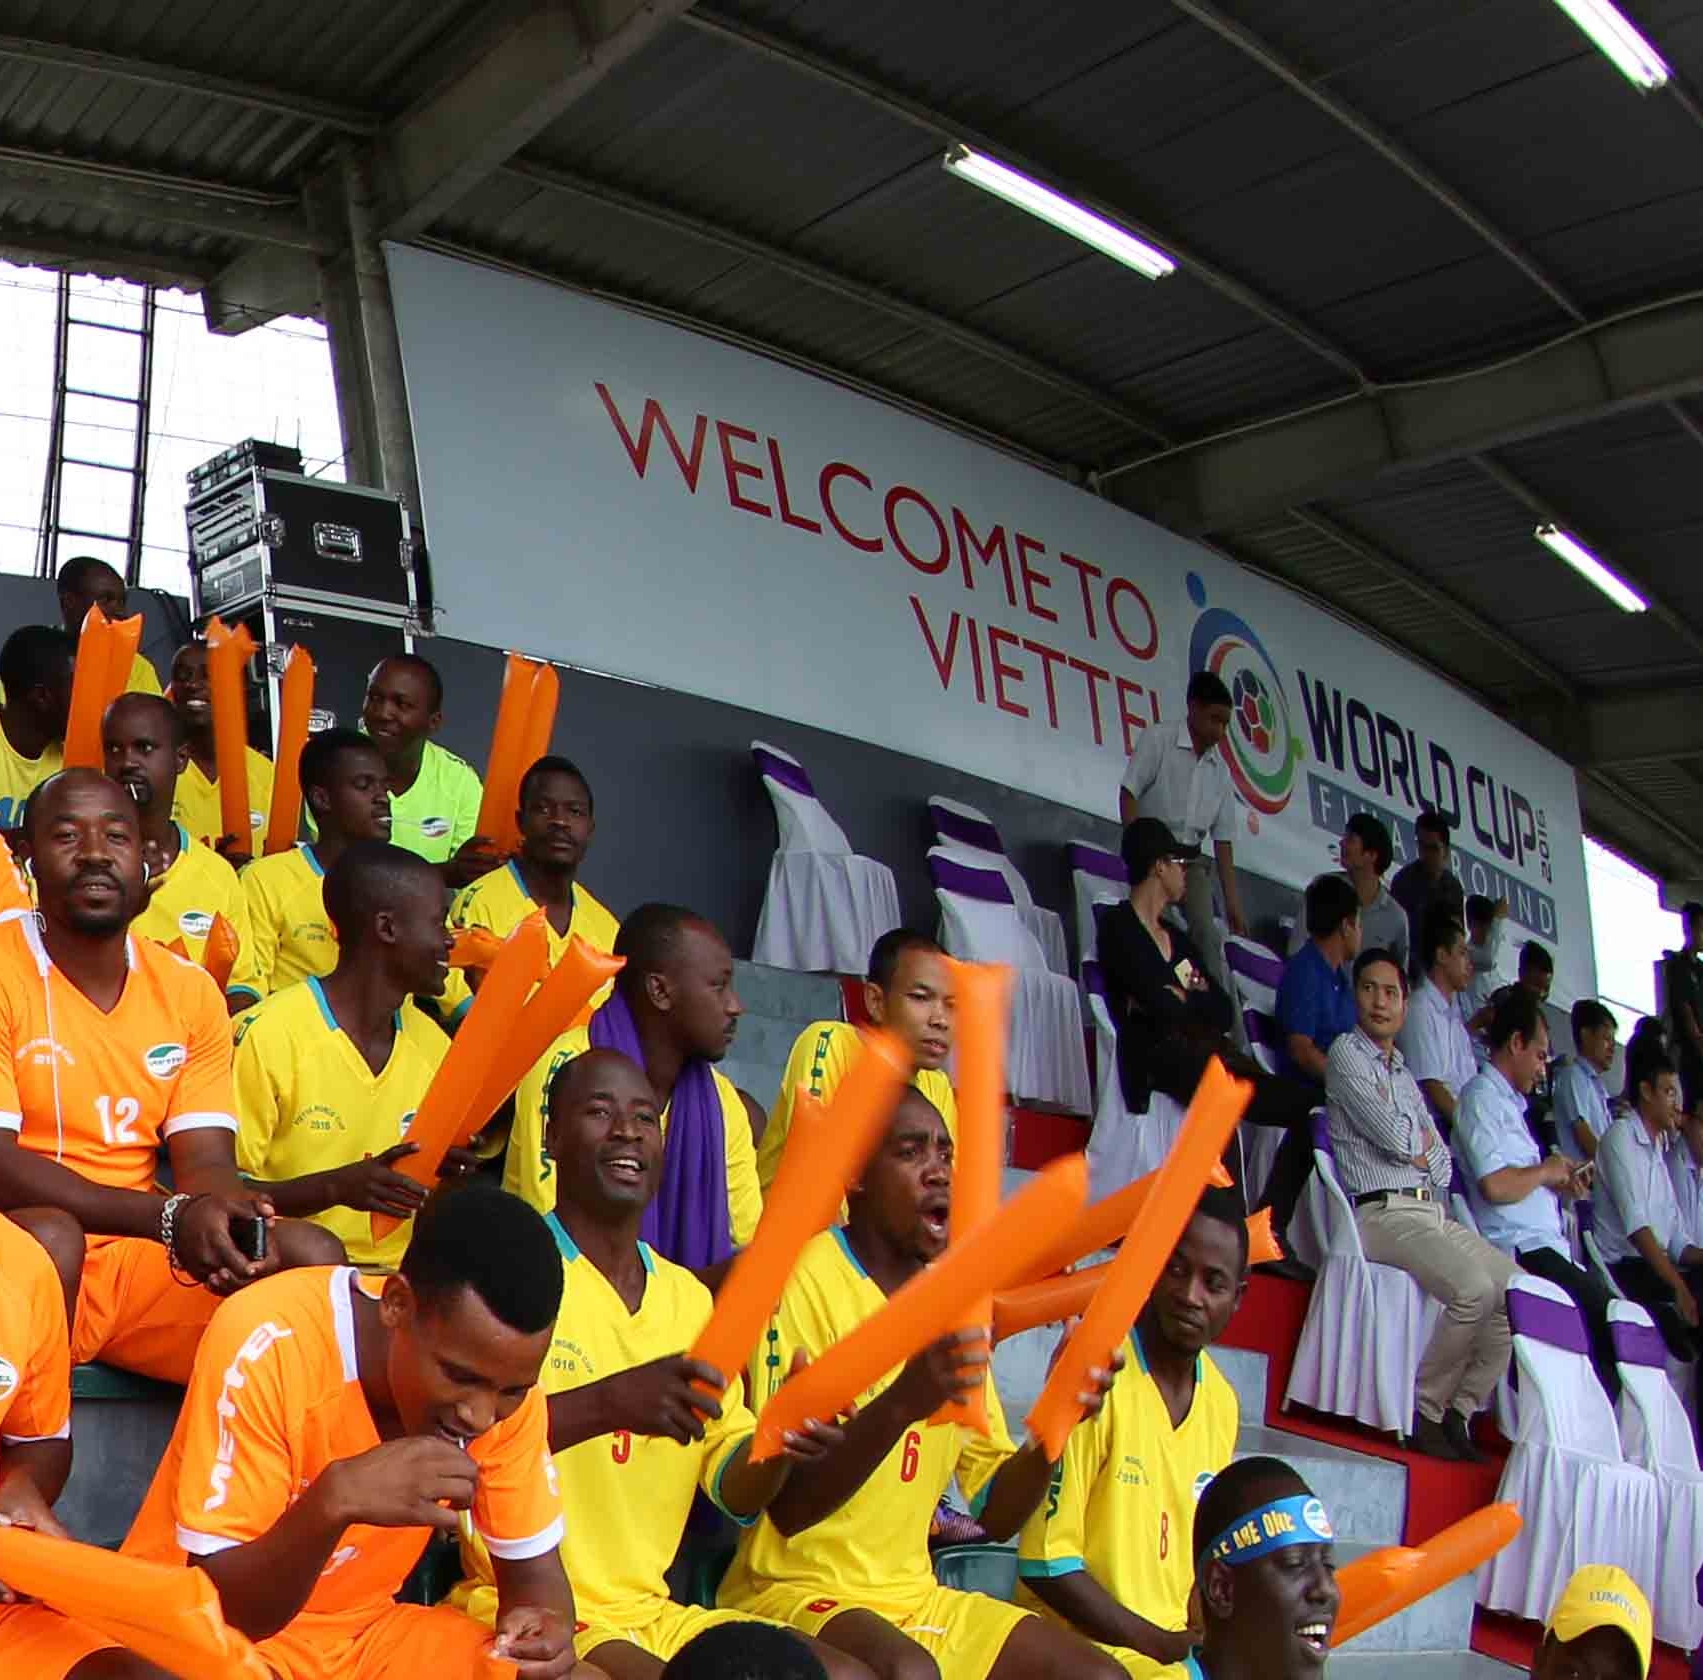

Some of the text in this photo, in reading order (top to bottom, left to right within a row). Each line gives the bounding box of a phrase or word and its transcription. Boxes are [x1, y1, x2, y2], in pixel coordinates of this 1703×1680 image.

[594, 375, 1159, 661] WELCOME TO
[1296, 668, 1537, 867] WORLD CUP
[1538, 808, 1554, 884] 2016
[94, 1095, 139, 1144] 12
[202, 1321, 294, 1514] VIETTEL
[900, 1430, 922, 1483] 6
[1159, 1510, 1170, 1561] 8
[1232, 1509, 1298, 1552] ARE ONE
